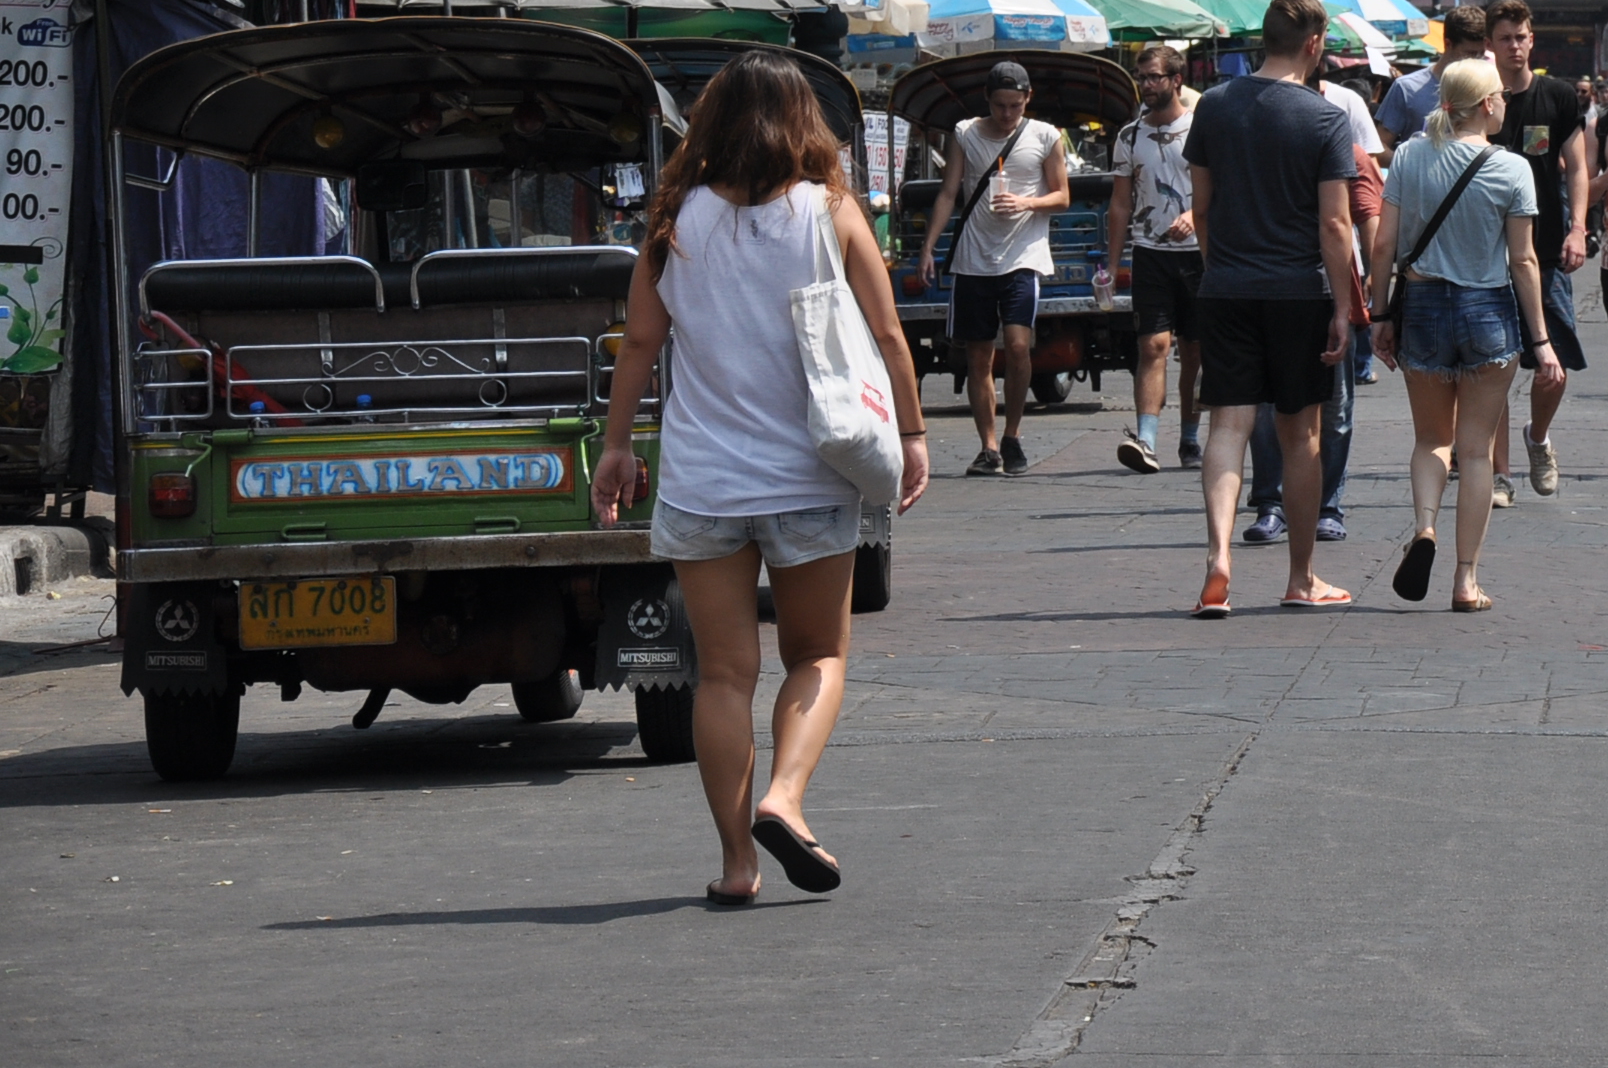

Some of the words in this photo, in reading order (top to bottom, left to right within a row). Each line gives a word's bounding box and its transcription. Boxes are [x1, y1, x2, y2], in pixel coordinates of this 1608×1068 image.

[252, 453, 551, 497] THAILAND
[308, 584, 387, 617] 7008
[266, 624, 371, 640] กรุงเทพมหานคร
[148, 655, 205, 667] MITSUBISHI
[619, 650, 678, 664] MITSUBISHI
